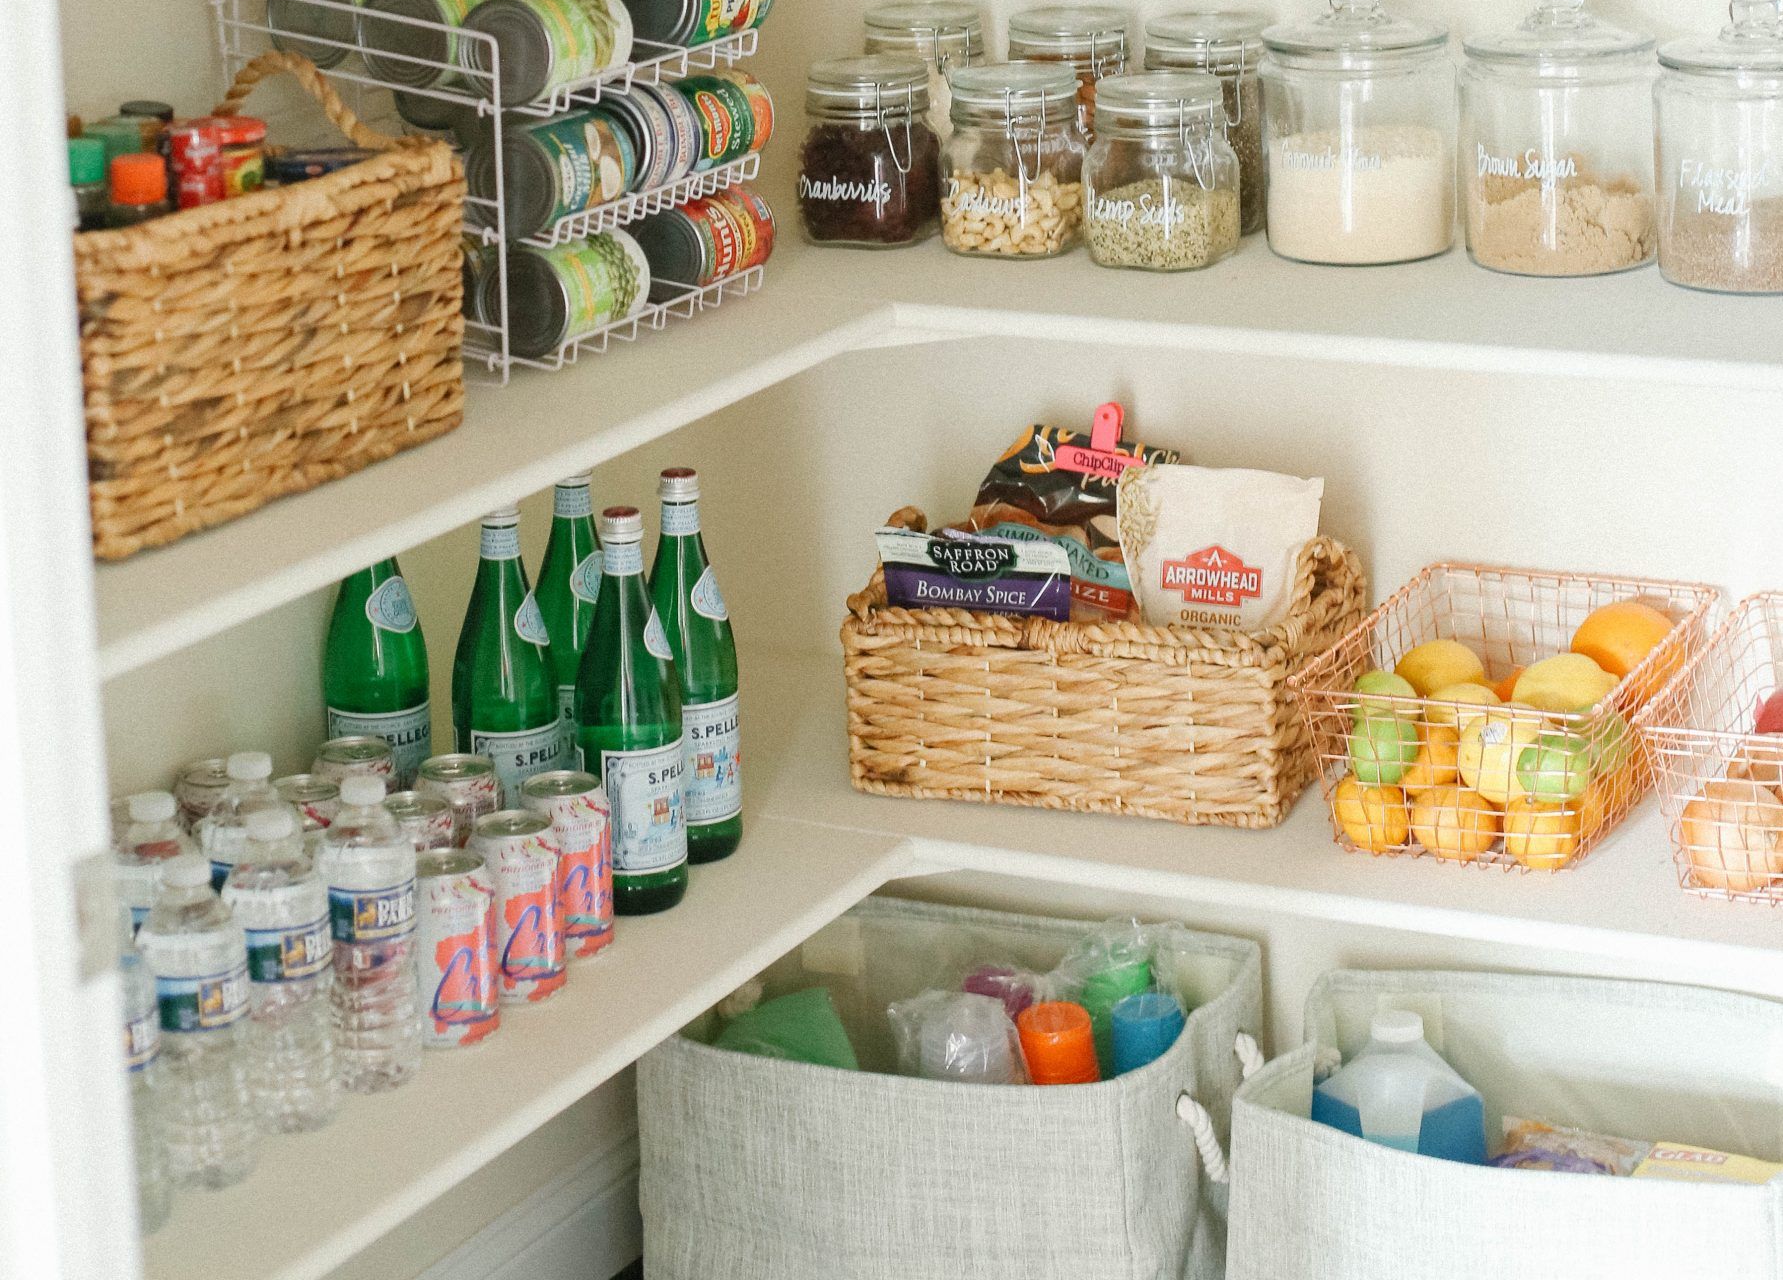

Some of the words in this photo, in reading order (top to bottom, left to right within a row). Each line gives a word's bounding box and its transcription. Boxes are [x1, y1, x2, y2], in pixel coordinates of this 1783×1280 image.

[716, 87, 742, 151] Stewed
[1477, 140, 1522, 178] Brown
[800, 173, 892, 205] Cranberries
[932, 545, 1010, 562] SAFFRON
[1057, 540, 1110, 580] NAKED
[949, 558, 998, 574] ROAD
[1165, 565, 1259, 593] ARROWHEAD
[1070, 584, 1110, 604] IZE
[1191, 587, 1235, 603] MILLS
[1180, 608, 1242, 627] ORGANIC
